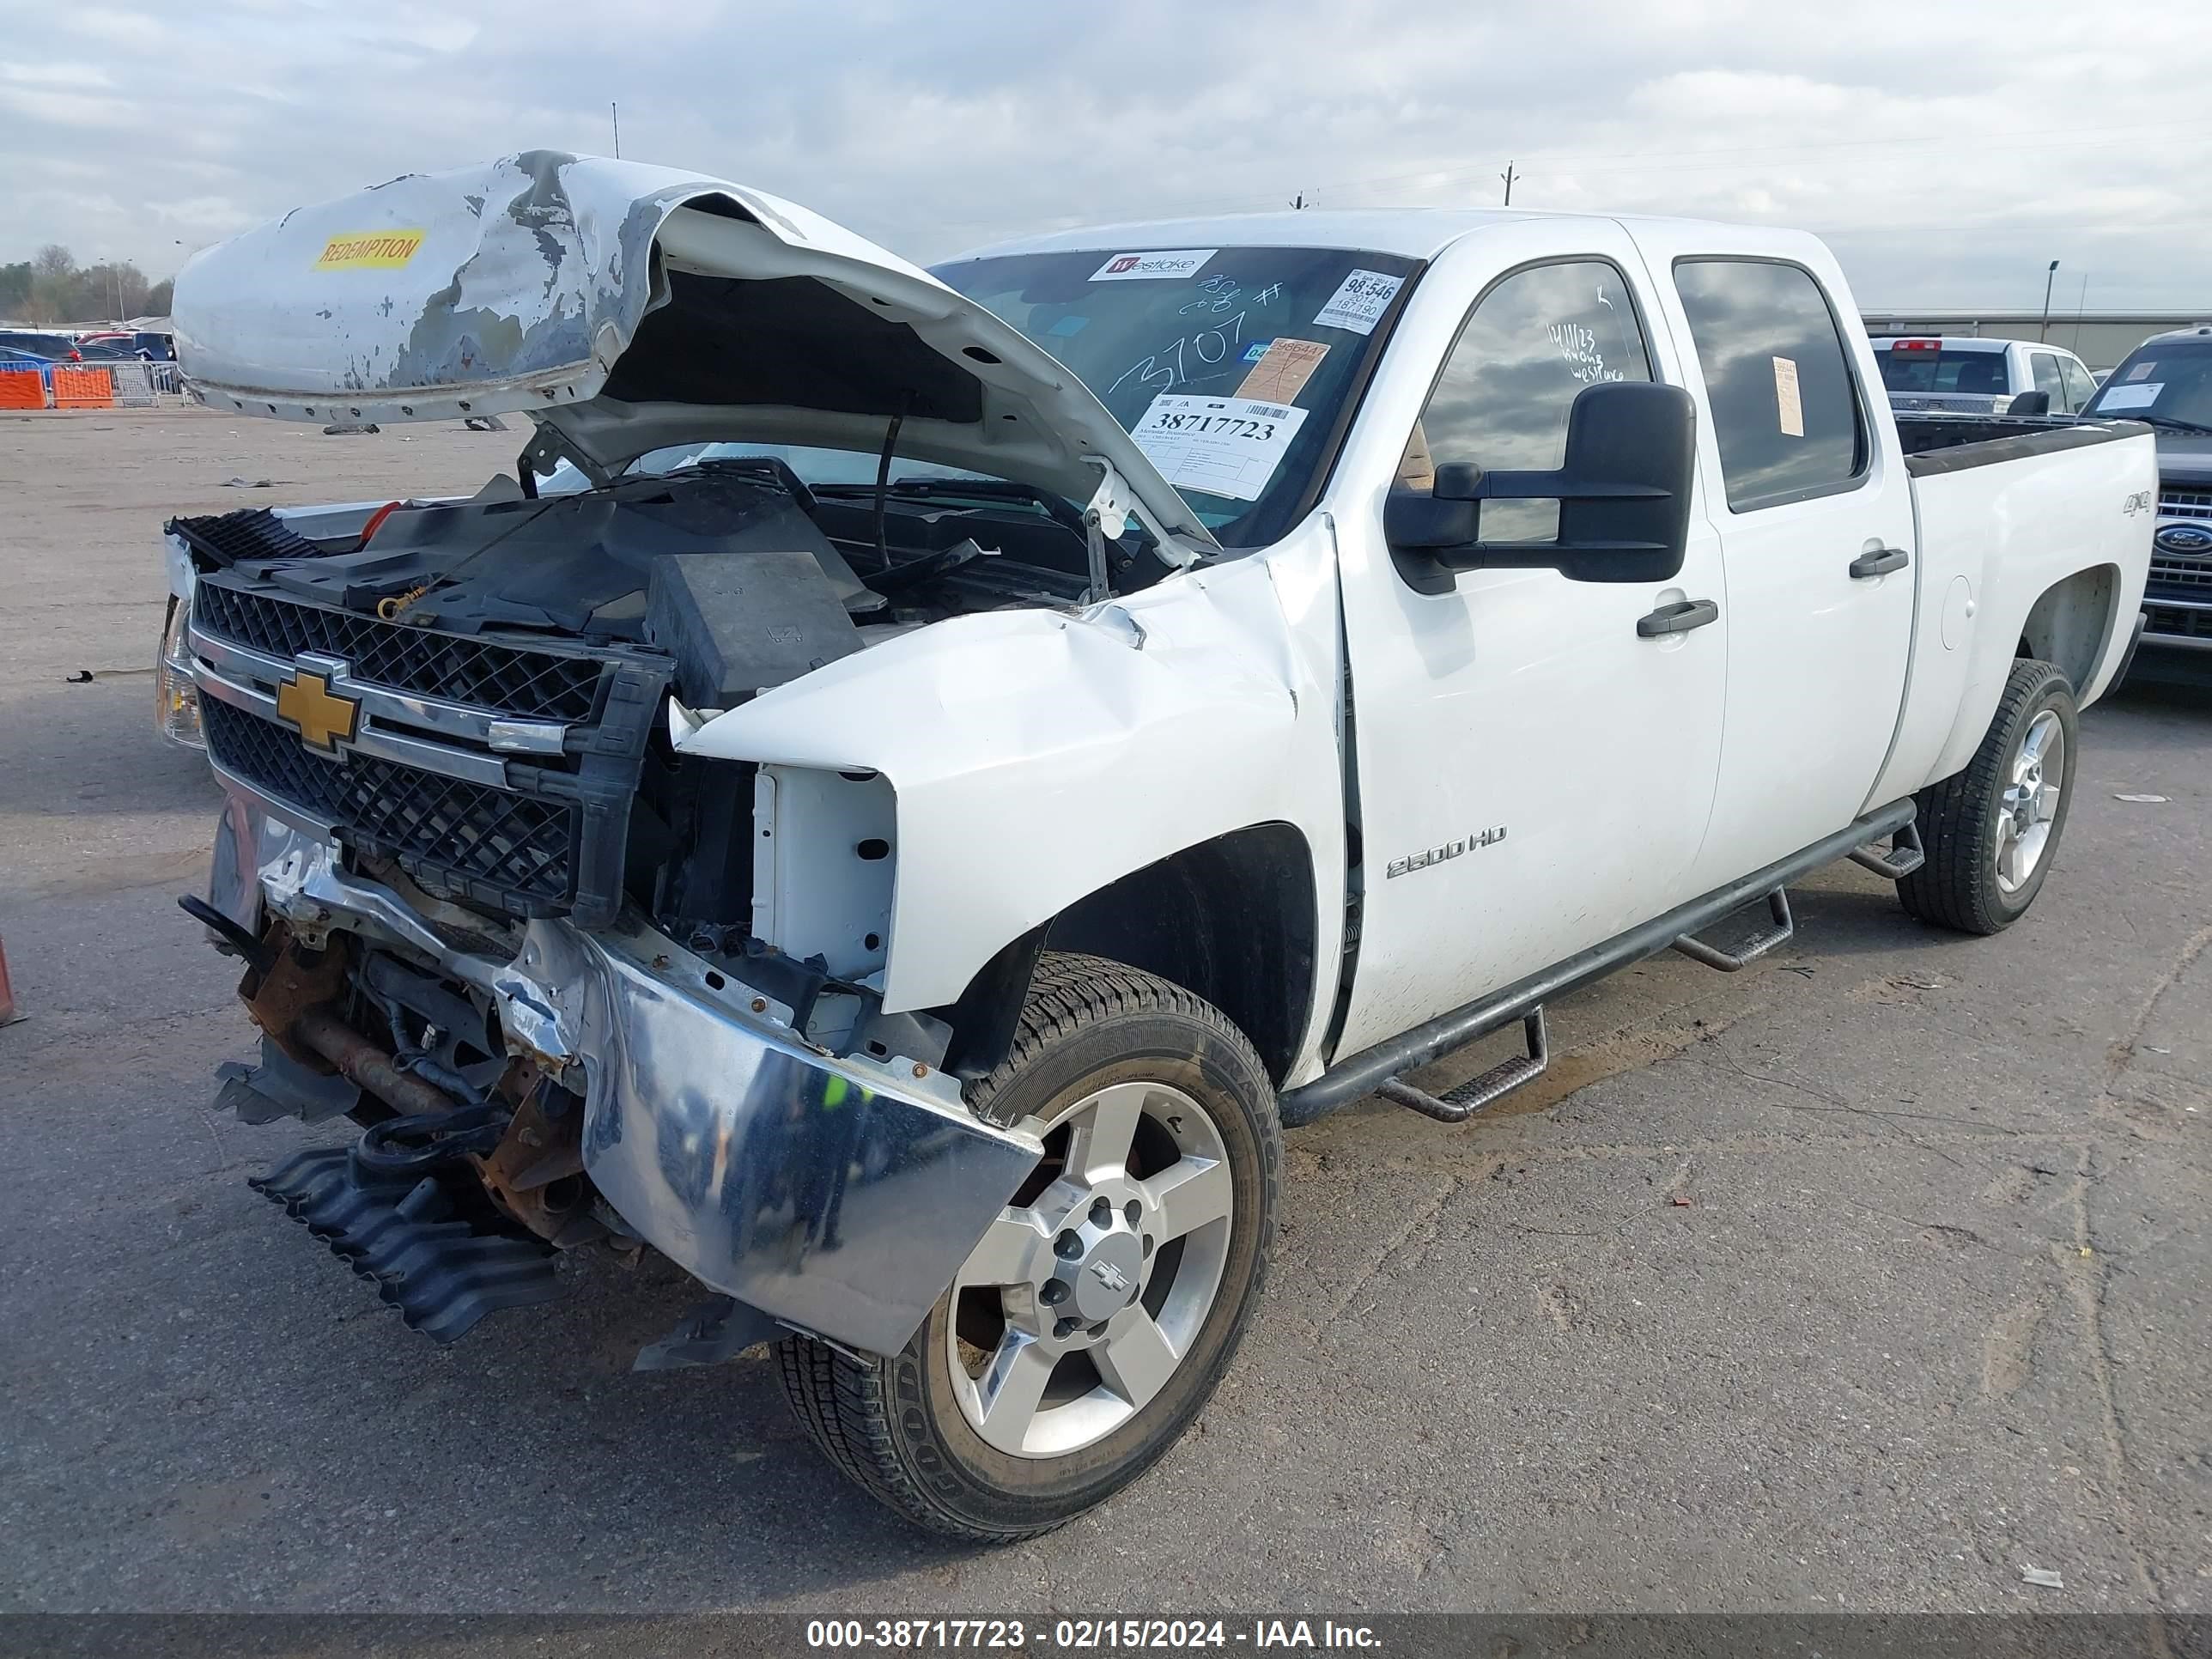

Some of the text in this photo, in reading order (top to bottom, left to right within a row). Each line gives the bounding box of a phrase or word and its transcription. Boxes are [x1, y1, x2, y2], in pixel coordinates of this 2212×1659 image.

[319, 238, 420, 263] REDEMPTION
[1114, 258, 1195, 270] Westlake
[1345, 278, 1395, 301] 98:546
[1349, 294, 1376, 305] 2014
[1151, 412, 1276, 441] 38717723
[2170, 532, 2203, 546] Ford
[1386, 823, 1508, 880] 2500 HD
